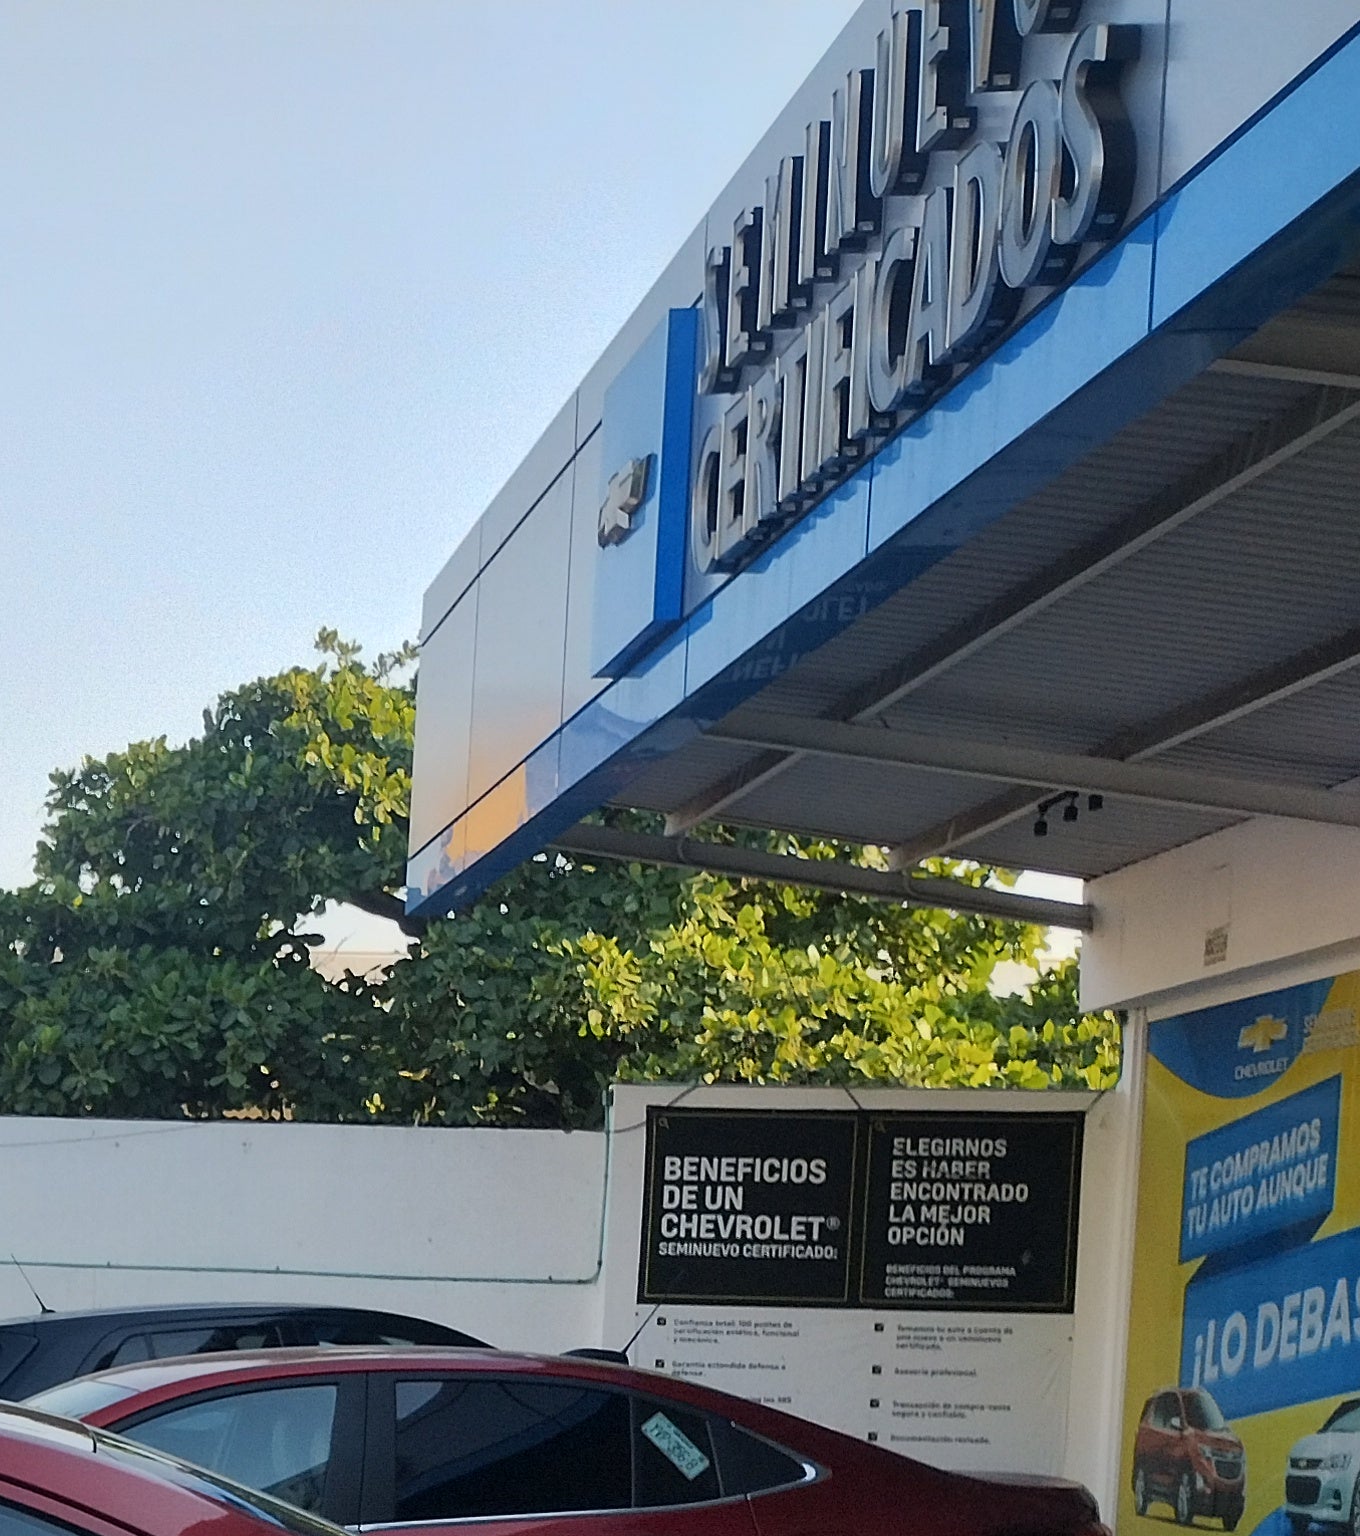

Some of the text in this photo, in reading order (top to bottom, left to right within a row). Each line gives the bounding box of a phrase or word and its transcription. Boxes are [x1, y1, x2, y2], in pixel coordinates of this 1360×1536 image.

[697, 0, 1060, 395] SEMINUE
[691, 24, 1125, 575] CERTIFICADOS
[892, 1137, 1008, 1158] ELEGIRNOS
[1191, 1118, 1322, 1201] TE COMPRAMOS
[663, 1155, 828, 1184] BENEFICIOS
[891, 1159, 991, 1180] ES HABER
[663, 1185, 744, 1210] DE UN
[890, 1181, 1029, 1202] ENCONTRADO
[1187, 1153, 1329, 1239] TU AUTO AUNQUE
[888, 1204, 991, 1224] LA MEJOR
[887, 1222, 964, 1246] OPCIÓN
[658, 1242, 740, 1258] SEMINUEVO
